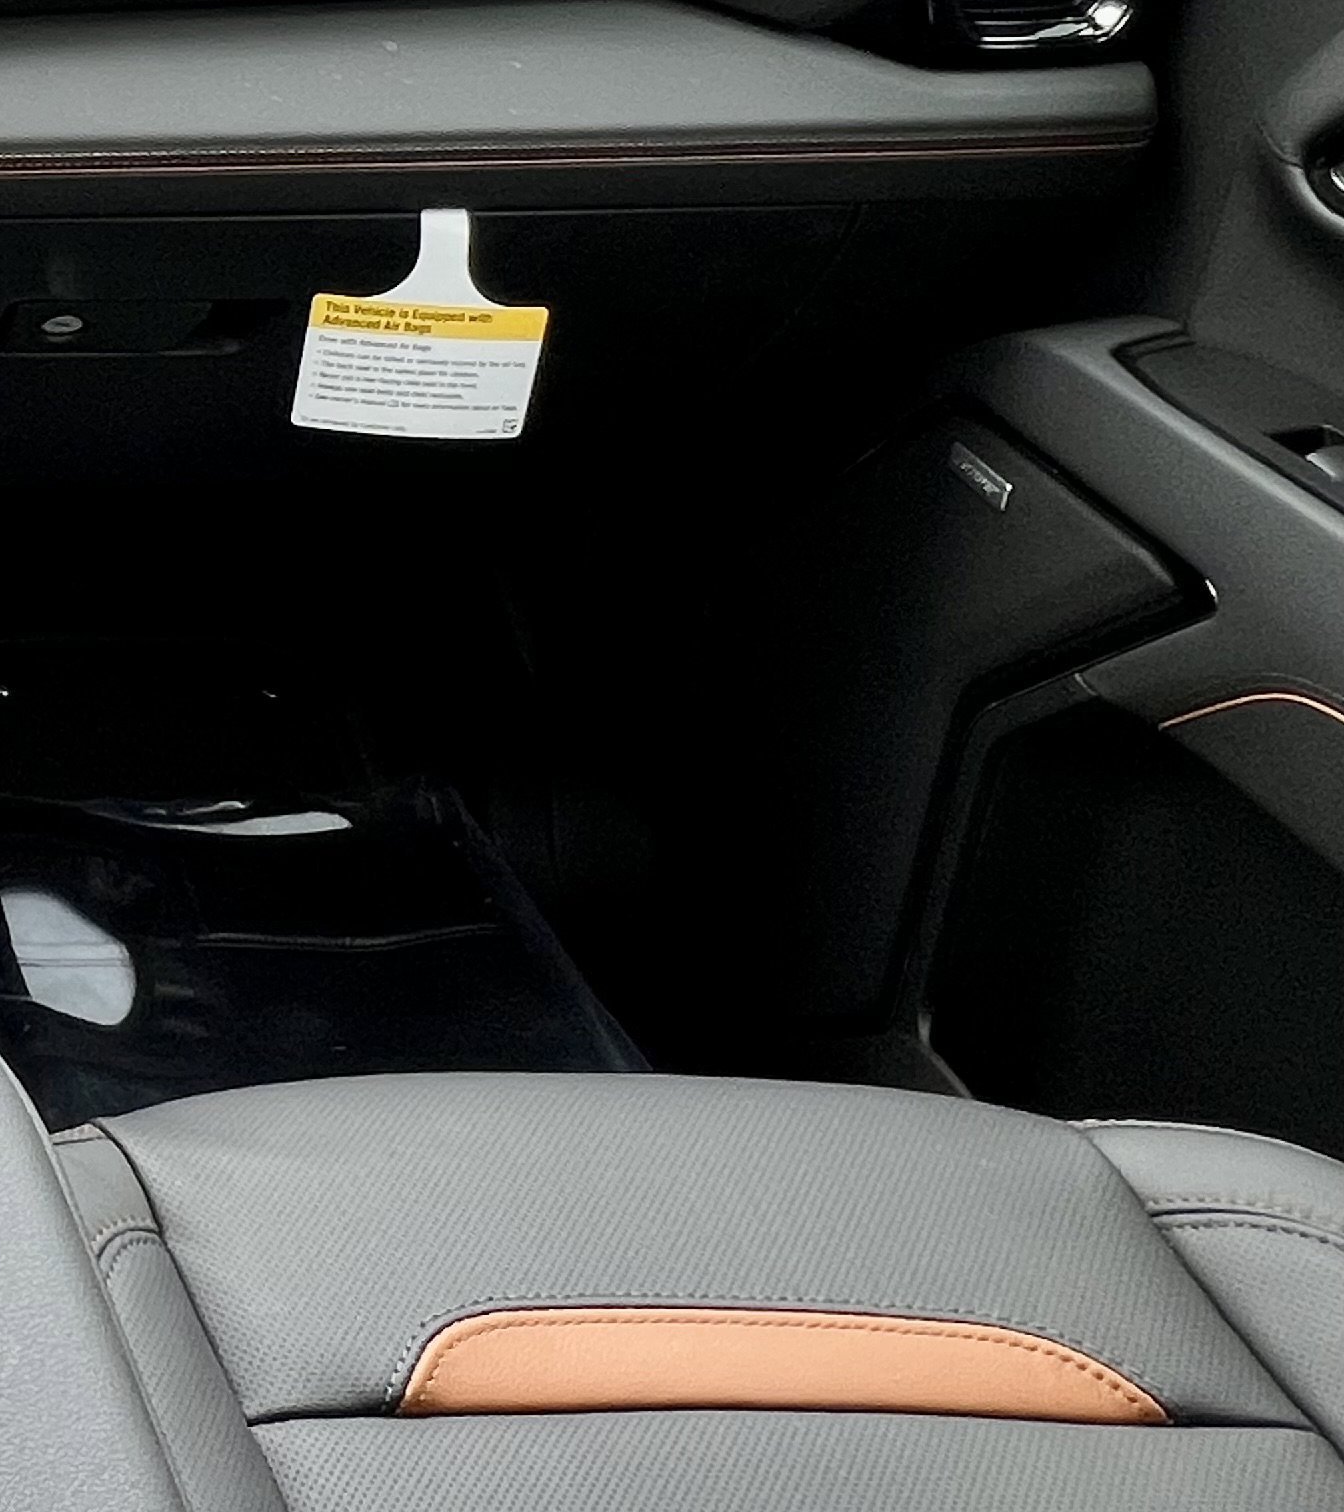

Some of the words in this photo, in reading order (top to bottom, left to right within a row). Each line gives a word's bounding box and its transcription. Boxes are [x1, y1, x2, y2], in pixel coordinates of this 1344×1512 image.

[325, 300, 350, 314] This
[354, 304, 396, 318] Vehicle
[399, 307, 409, 319] is
[412, 309, 465, 323] Equipped
[469, 313, 493, 323] with
[323, 314, 381, 330] Advanced
[384, 320, 400, 332] Air
[404, 322, 432, 335] Bags
